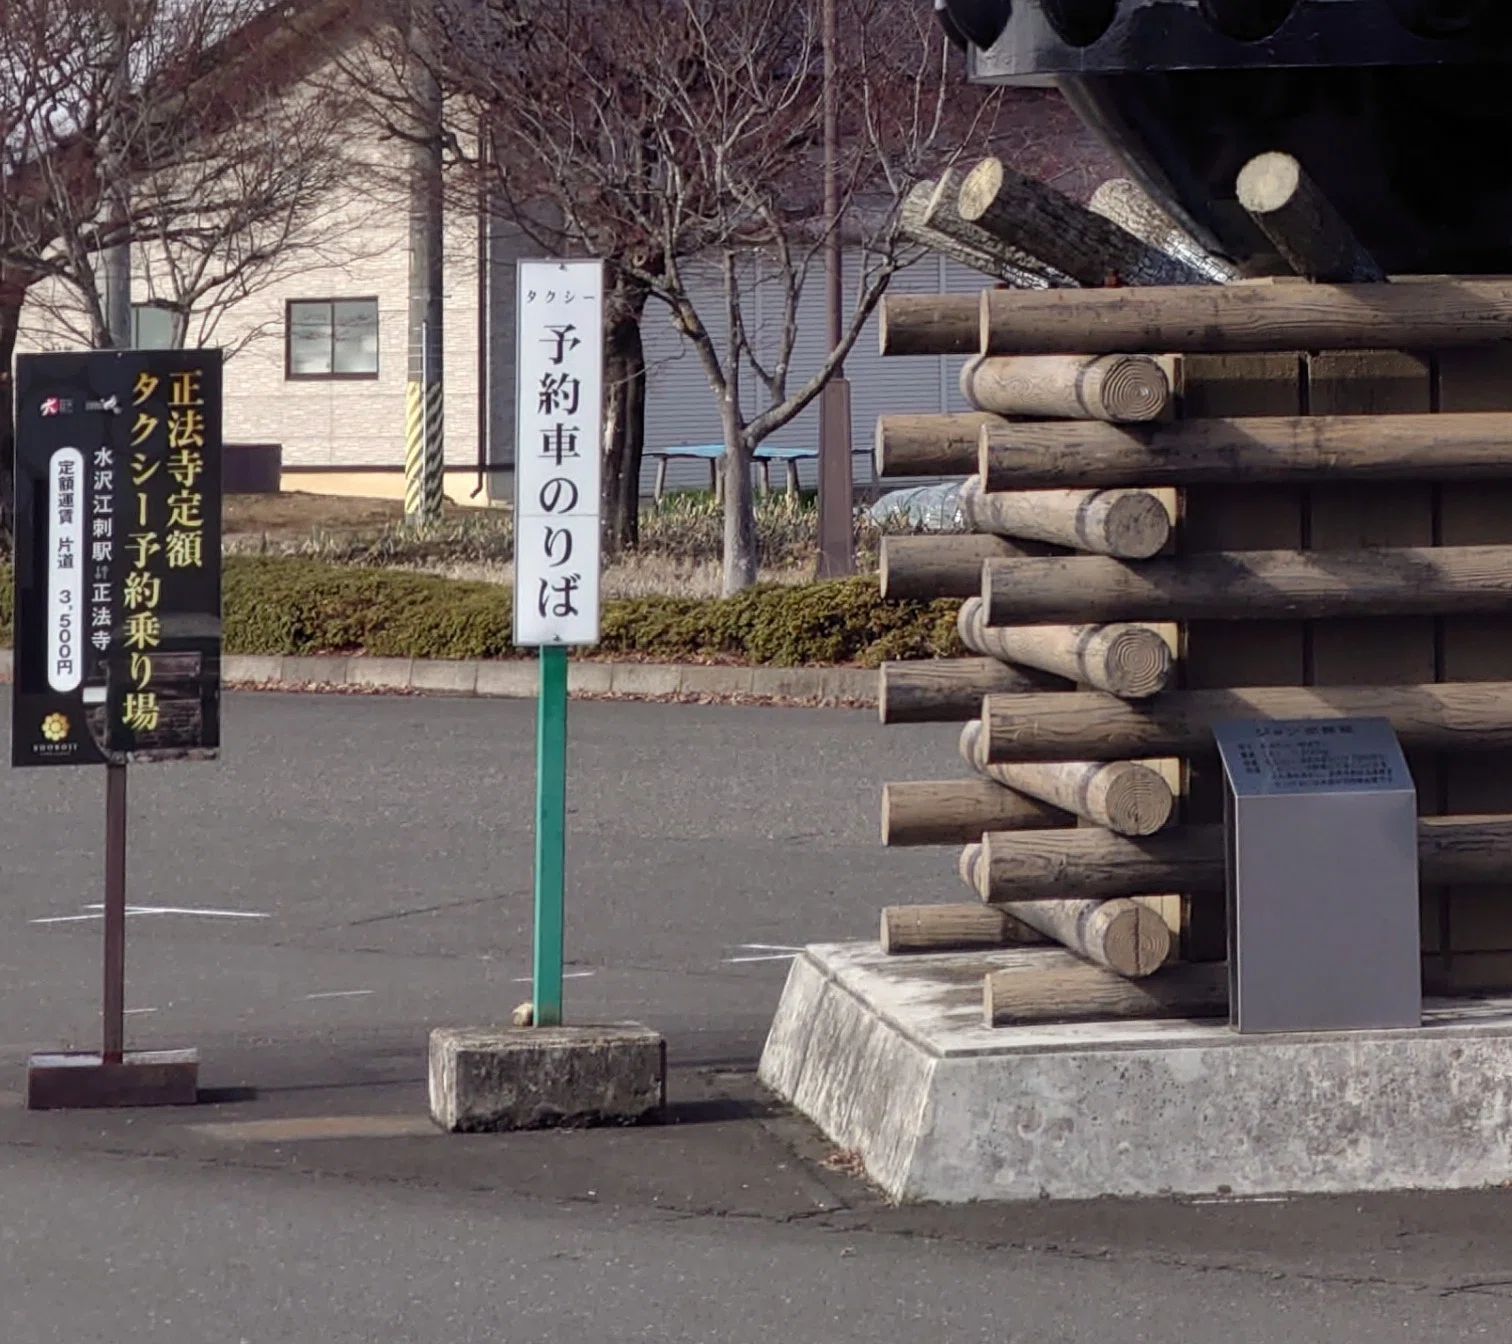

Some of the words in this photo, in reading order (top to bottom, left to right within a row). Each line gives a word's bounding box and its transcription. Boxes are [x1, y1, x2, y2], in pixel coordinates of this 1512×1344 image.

[526, 289, 596, 305] タクシー
[123, 373, 160, 730] タクシー予約乗り場
[166, 370, 204, 568] 正法寺定額
[537, 323, 581, 618] 予約車のりば
